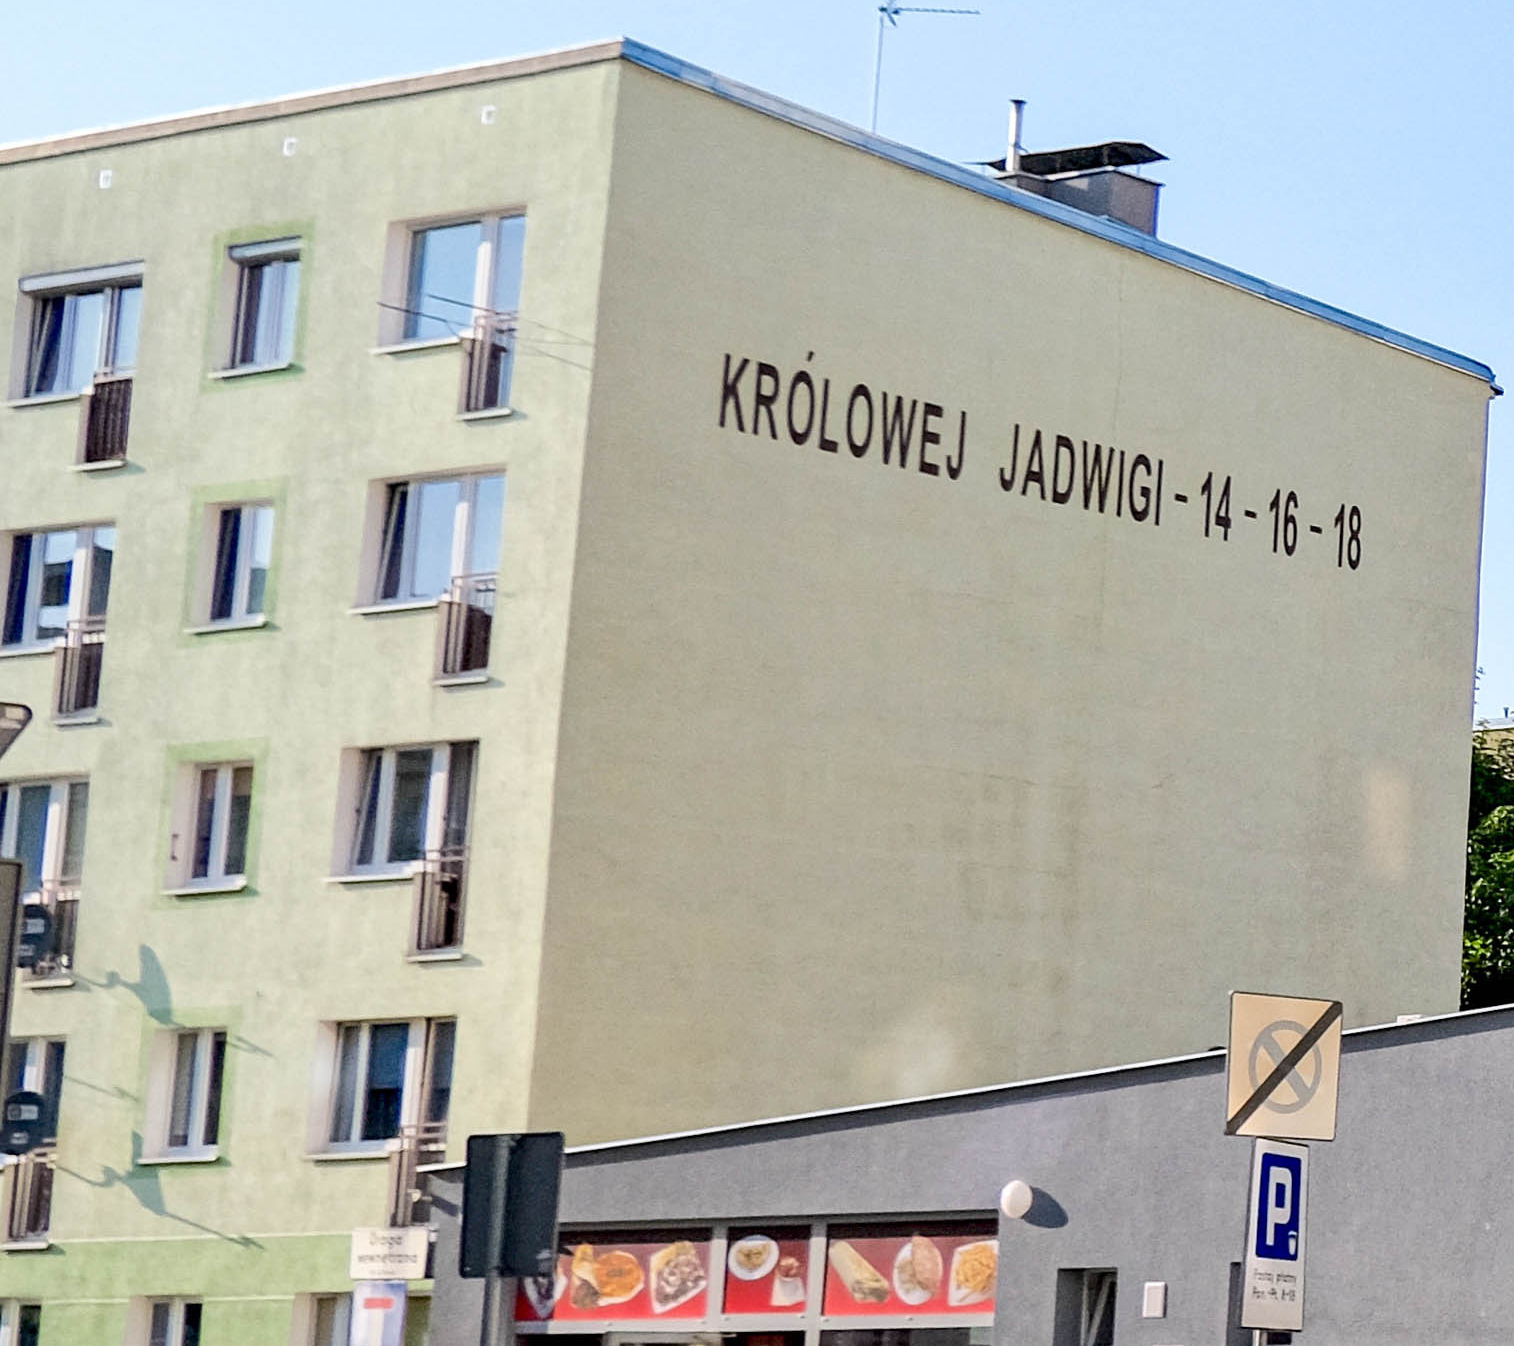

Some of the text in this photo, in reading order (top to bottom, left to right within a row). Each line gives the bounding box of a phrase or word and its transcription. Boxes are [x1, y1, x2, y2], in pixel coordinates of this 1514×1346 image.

[718, 350, 967, 481] KRÓLOWEJ
[1000, 423, 1164, 527] JADWIGI
[1201, 471, 1232, 542] 14
[1269, 488, 1299, 557] 16
[1334, 503, 1362, 571] 18
[1266, 1166, 1292, 1246] P
